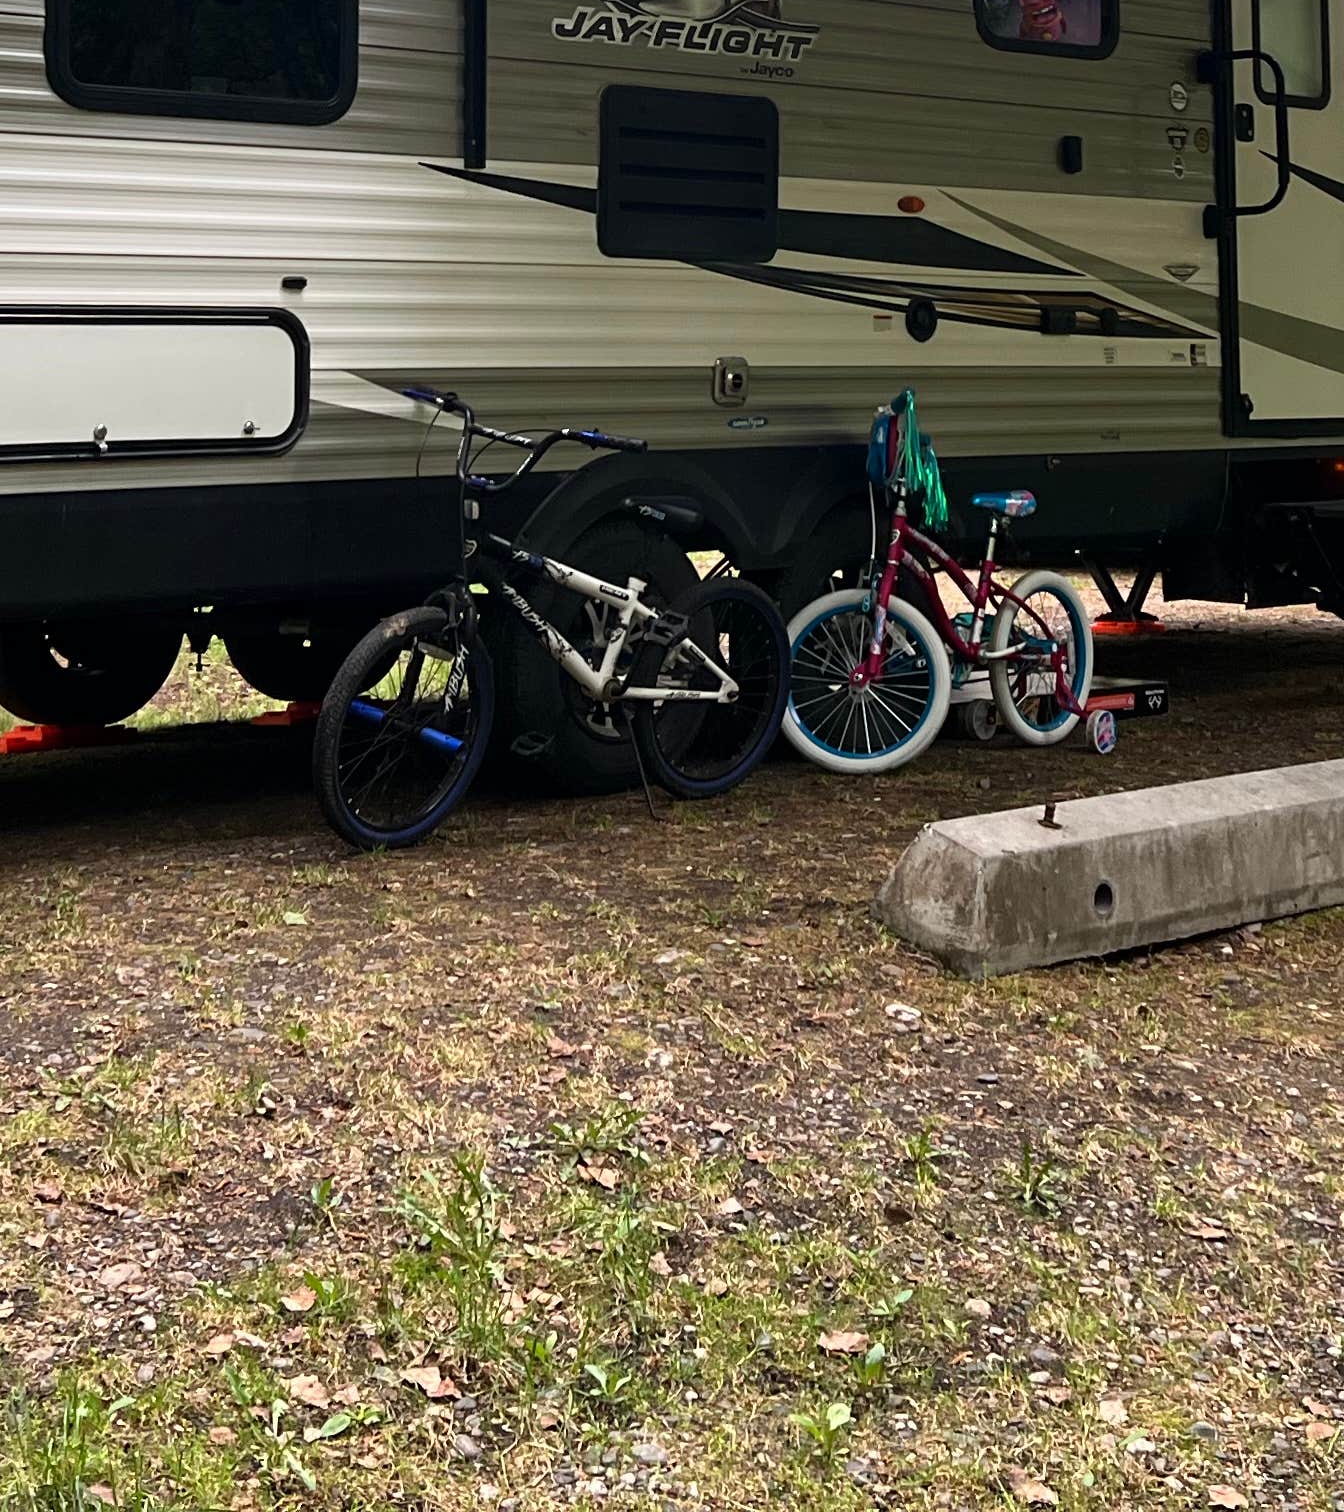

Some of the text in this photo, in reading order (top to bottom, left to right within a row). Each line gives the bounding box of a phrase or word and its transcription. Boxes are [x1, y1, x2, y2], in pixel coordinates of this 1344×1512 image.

[552, 7, 816, 61] JAY FLIGHT
[749, 61, 795, 78] Jayco
